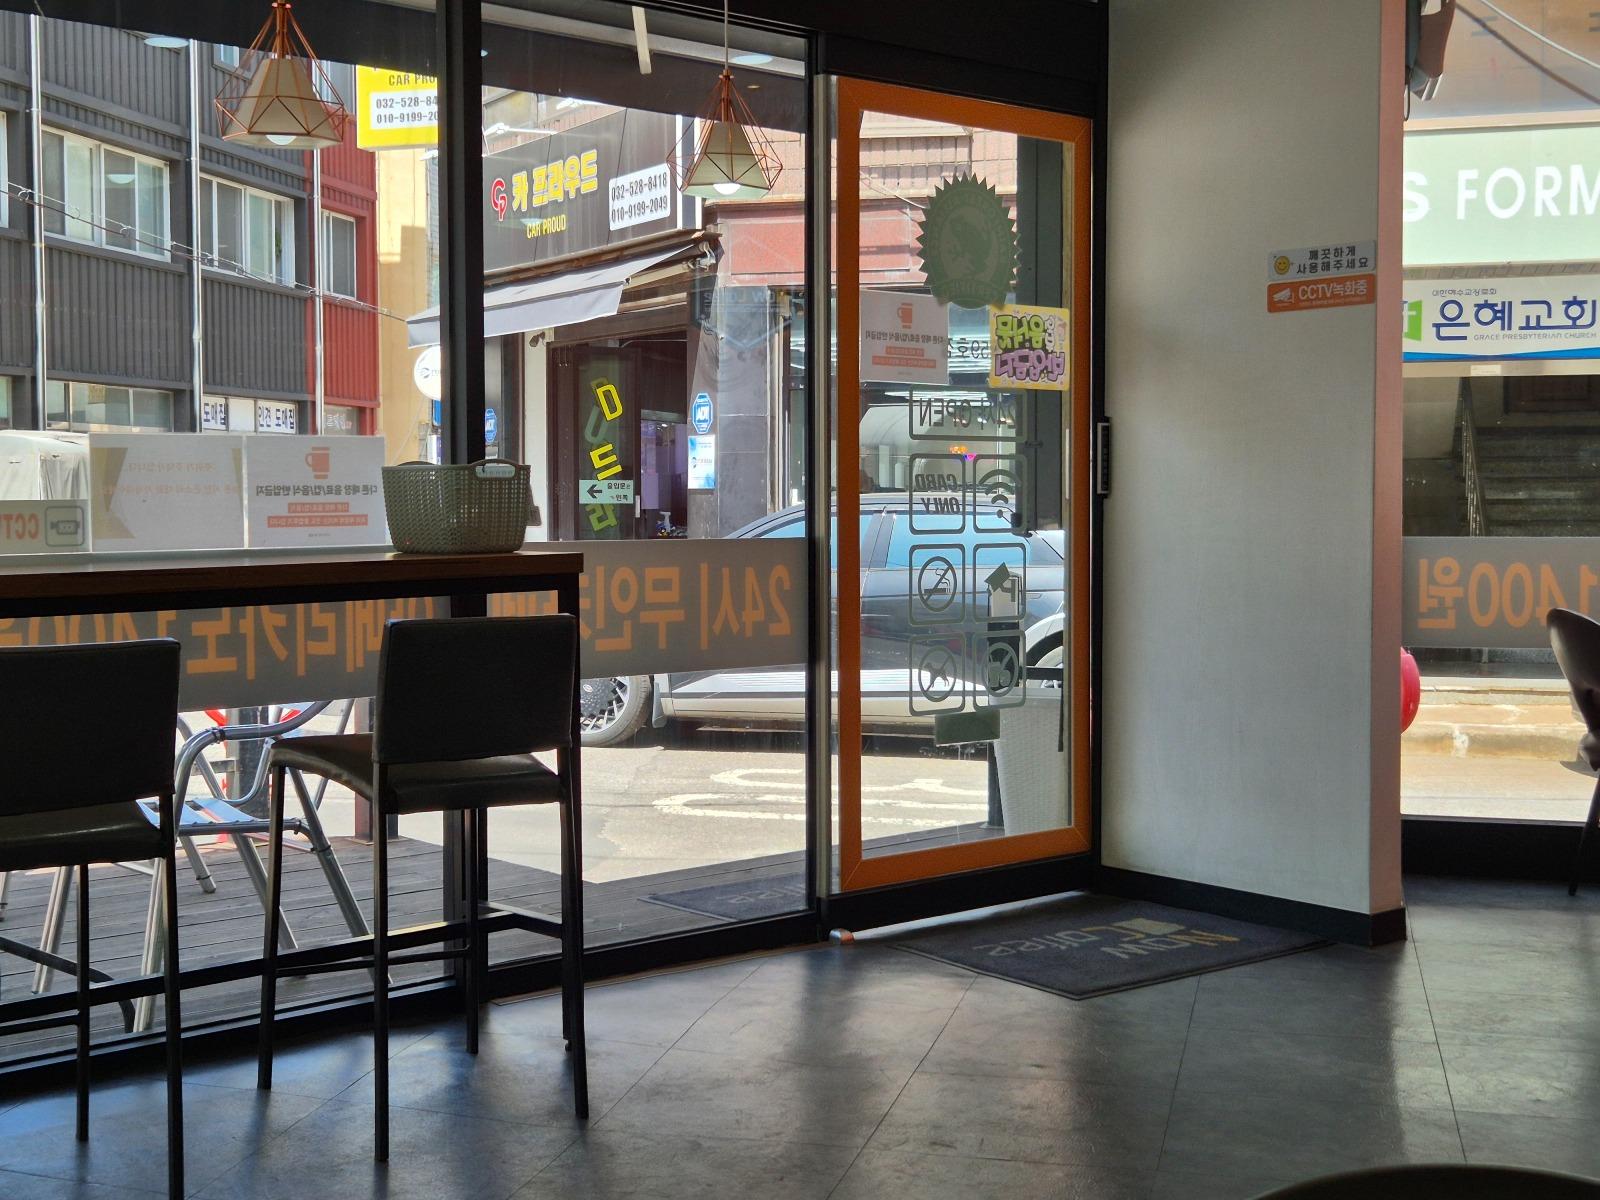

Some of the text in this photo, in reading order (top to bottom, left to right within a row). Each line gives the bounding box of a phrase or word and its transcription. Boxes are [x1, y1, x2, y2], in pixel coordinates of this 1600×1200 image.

[388, 74, 410, 87] CAR
[512, 149, 598, 212] 카 프라우드
[612, 172, 667, 202] 032-528-8418
[611, 196, 668, 224] 010-9199-2049
[526, 214, 567, 240] CAR PROUD
[1296, 257, 1368, 275] 사용해주세요
[1308, 246, 1356, 261] 깨끗하게
[1432, 295, 1597, 342] 은혜교회
[1564, 332, 1597, 340] CHURCH
